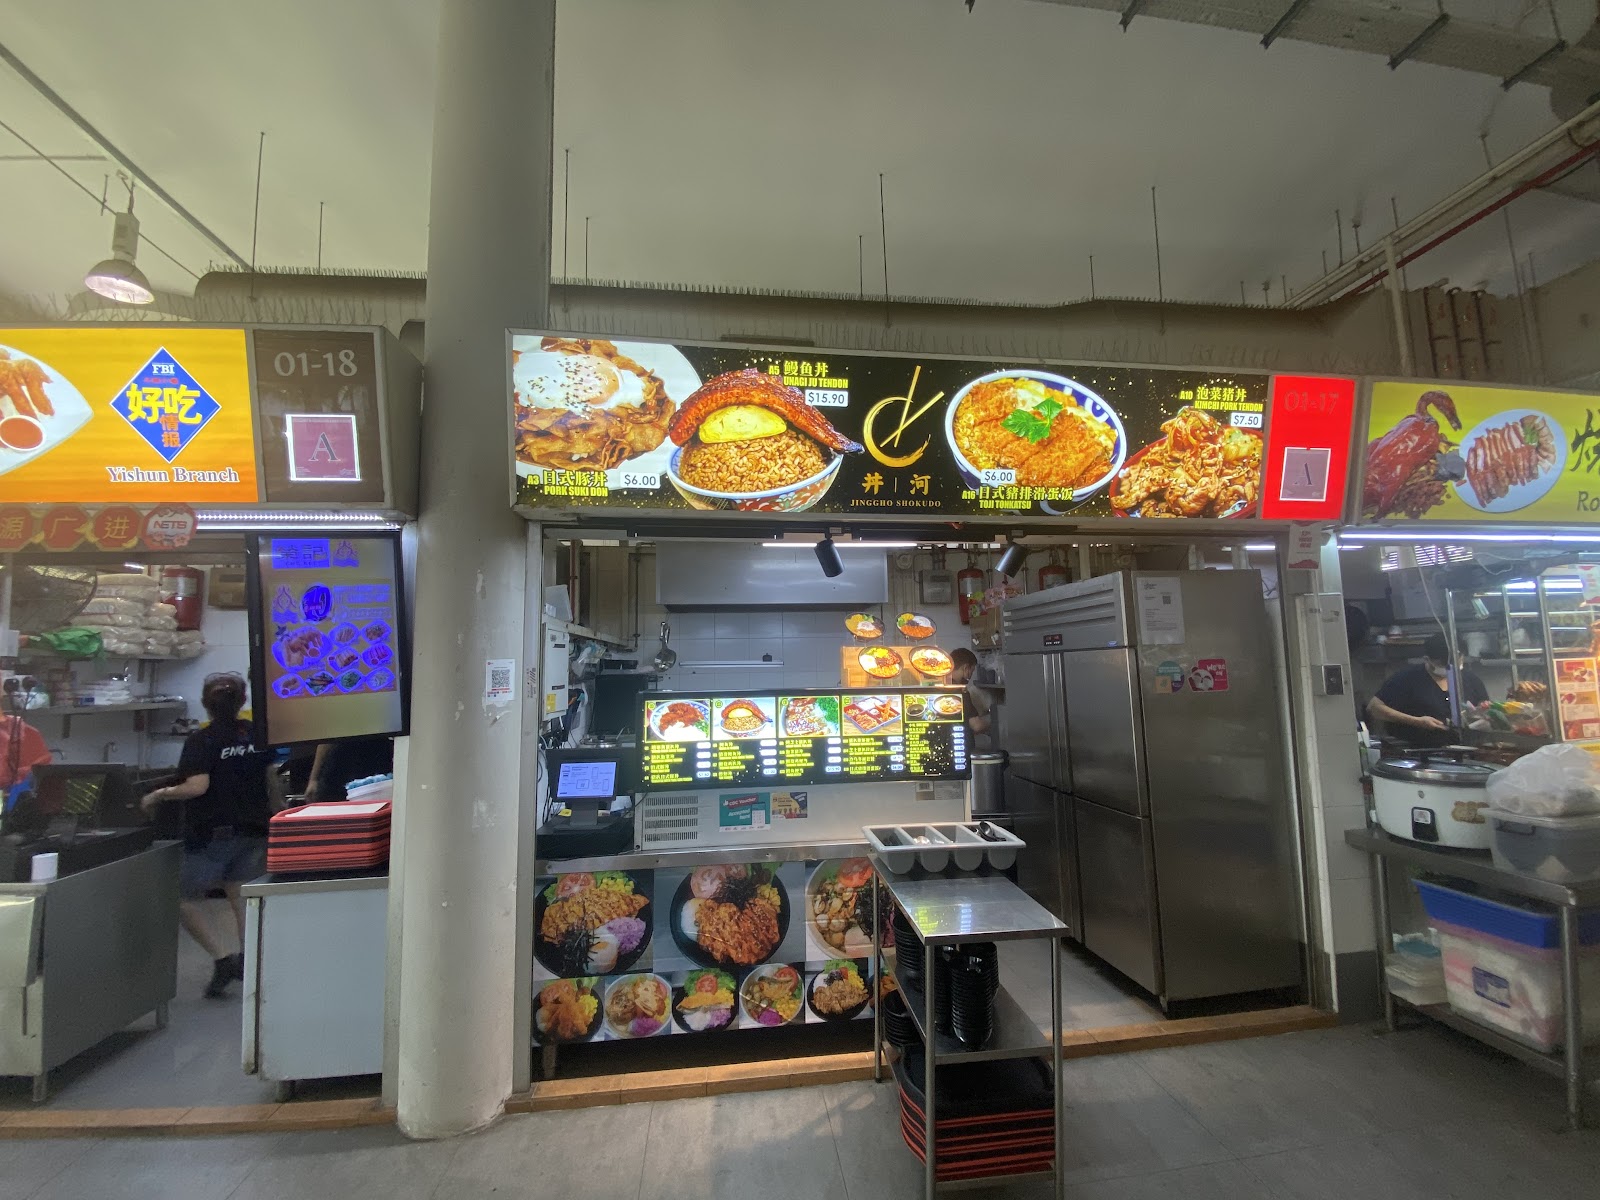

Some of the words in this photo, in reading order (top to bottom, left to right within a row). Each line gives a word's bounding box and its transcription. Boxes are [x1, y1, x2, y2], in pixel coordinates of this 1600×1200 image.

[274, 349, 358, 377] 01-18
[152, 364, 175, 374] FBI
[768, 365, 780, 375] A5
[783, 376, 808, 387] UNAGI
[808, 377, 817, 387] JU
[819, 378, 849, 389] TENDON
[808, 391, 845, 405] $15.90
[1179, 390, 1193, 400] A10
[126, 382, 203, 424] 好吃
[1194, 400, 1219, 410] KIMCHI
[1220, 401, 1238, 411] PORK
[1233, 414, 1259, 426] $7.50
[159, 415, 181, 448] 情报
[308, 432, 342, 462] A
[107, 467, 169, 482] Yishun
[173, 467, 240, 482] Branch
[527, 475, 540, 485] A3
[624, 473, 657, 487] $6.00
[984, 471, 1013, 482] $6.00
[909, 473, 932, 496] 河
[544, 486, 568, 496] PORK
[568, 486, 589, 497] SUKI
[590, 486, 608, 497] DON
[850, 499, 893, 507] JINGGHO
[896, 500, 941, 508] SHOKUDO
[979, 500, 994, 509] TOJI
[995, 500, 1032, 510] TONKATSU
[153, 520, 188, 531] NETS
